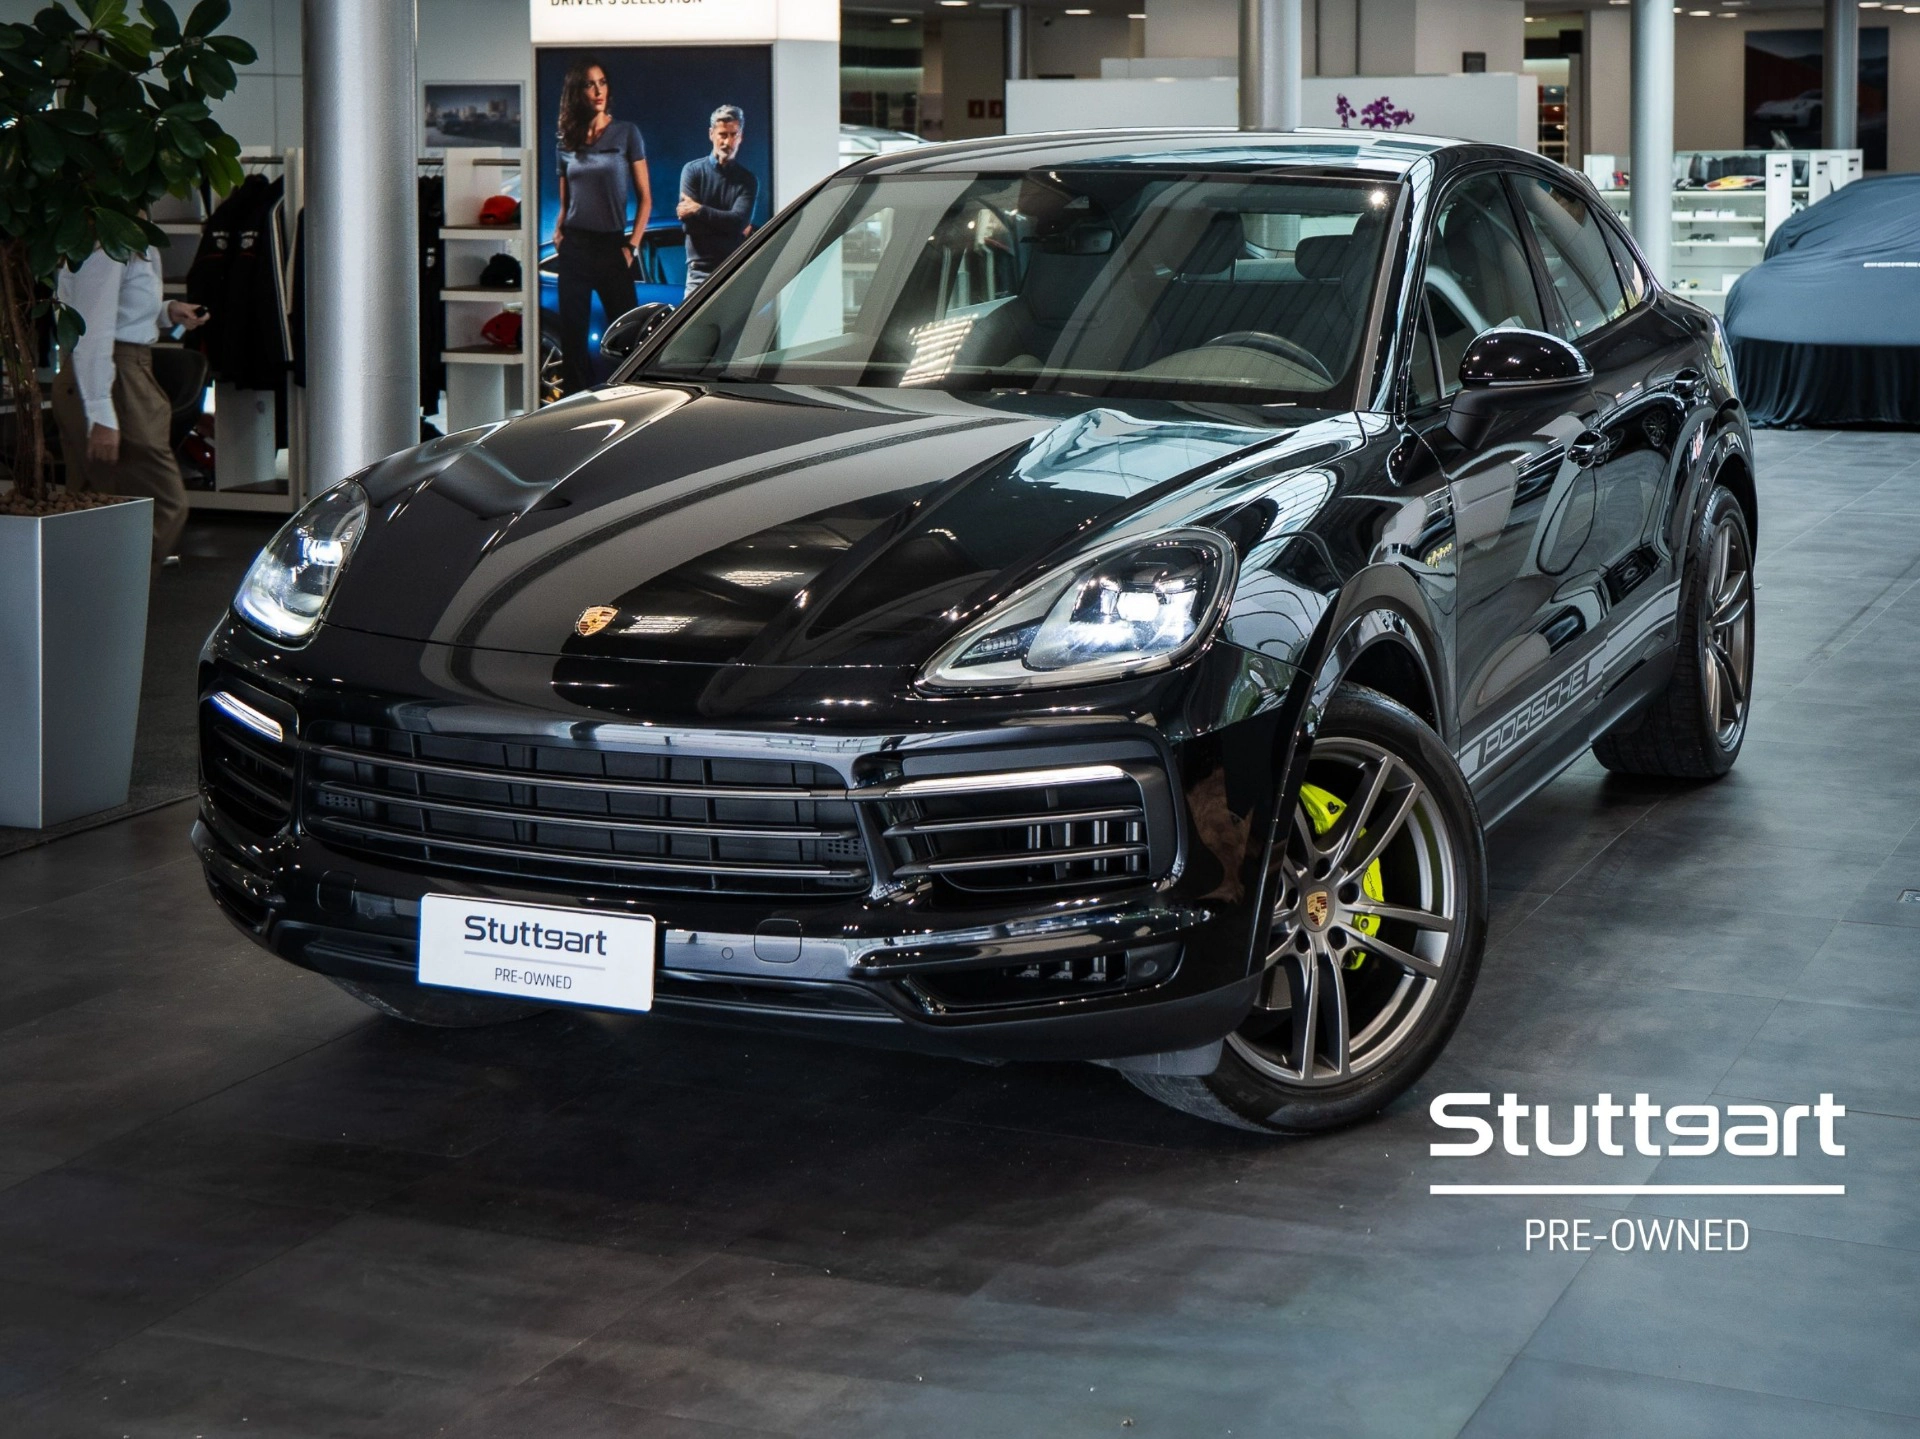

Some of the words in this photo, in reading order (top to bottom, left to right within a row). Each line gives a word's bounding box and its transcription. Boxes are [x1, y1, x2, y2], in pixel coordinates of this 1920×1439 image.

[1483, 664, 1586, 763] PORSCHE
[464, 915, 607, 956] Stuttgart
[494, 967, 572, 990] PRE-OWNED
